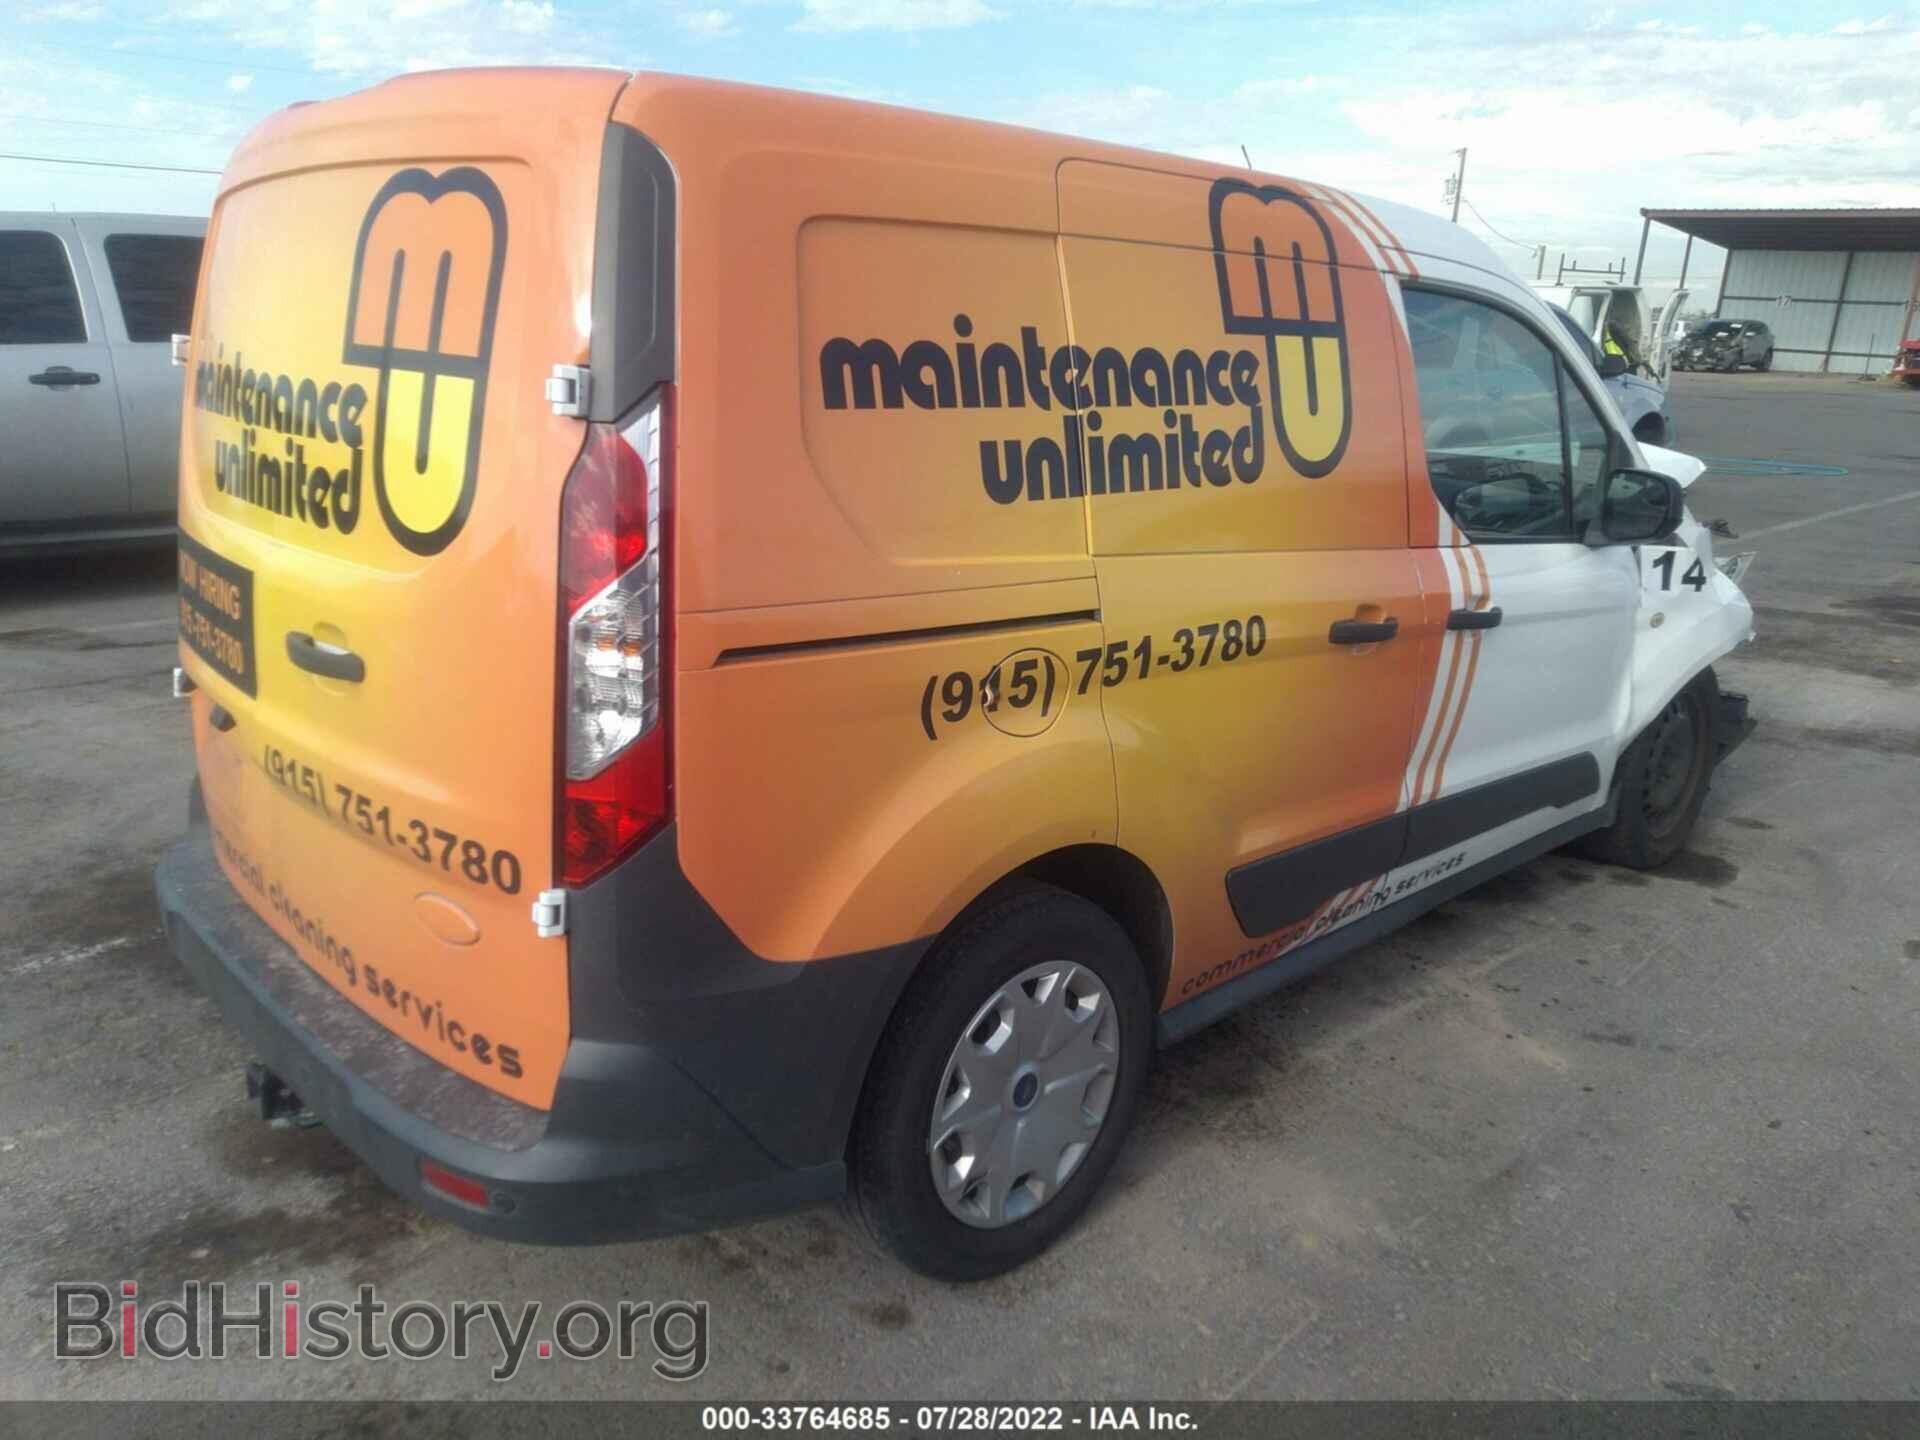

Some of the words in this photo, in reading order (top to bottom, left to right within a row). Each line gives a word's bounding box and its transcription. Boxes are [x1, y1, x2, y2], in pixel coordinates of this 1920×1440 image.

[820, 313, 1261, 411] maintenance
[215, 428, 364, 535] unlimited
[979, 407, 1264, 505] unlimited
[1652, 550, 1707, 592] 14
[921, 656, 1056, 741] (915)
[1076, 614, 1267, 695] 751-3780
[264, 744, 334, 817] (915)
[335, 783, 522, 895] 751-3780
[364, 963, 524, 1079] services
